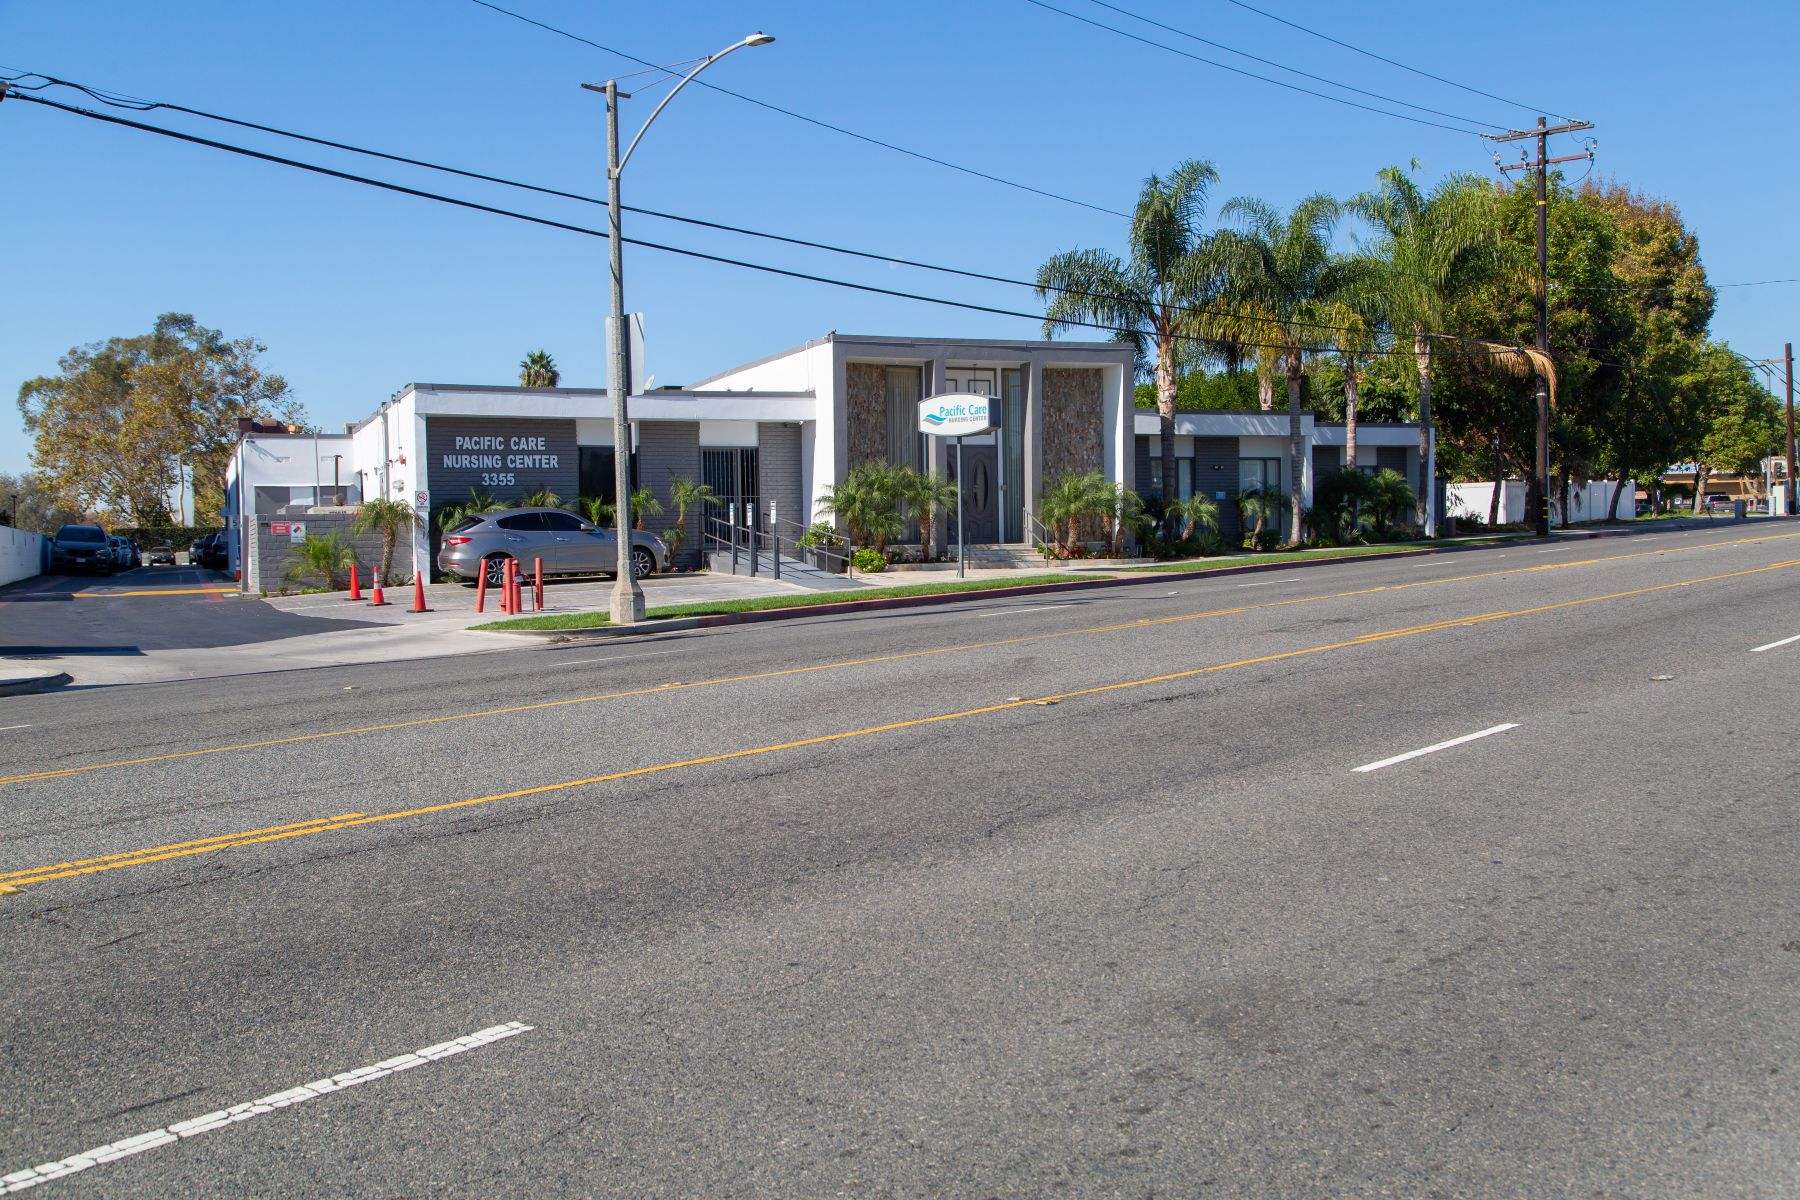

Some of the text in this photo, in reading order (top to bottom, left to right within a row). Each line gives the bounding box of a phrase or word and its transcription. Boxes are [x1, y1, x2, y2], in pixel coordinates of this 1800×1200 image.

[939, 404, 987, 417] Pacific Care
[455, 436, 546, 450] PACIFIC CARE
[443, 455, 559, 468] NURSING CENTER
[481, 473, 515, 486] 3355
